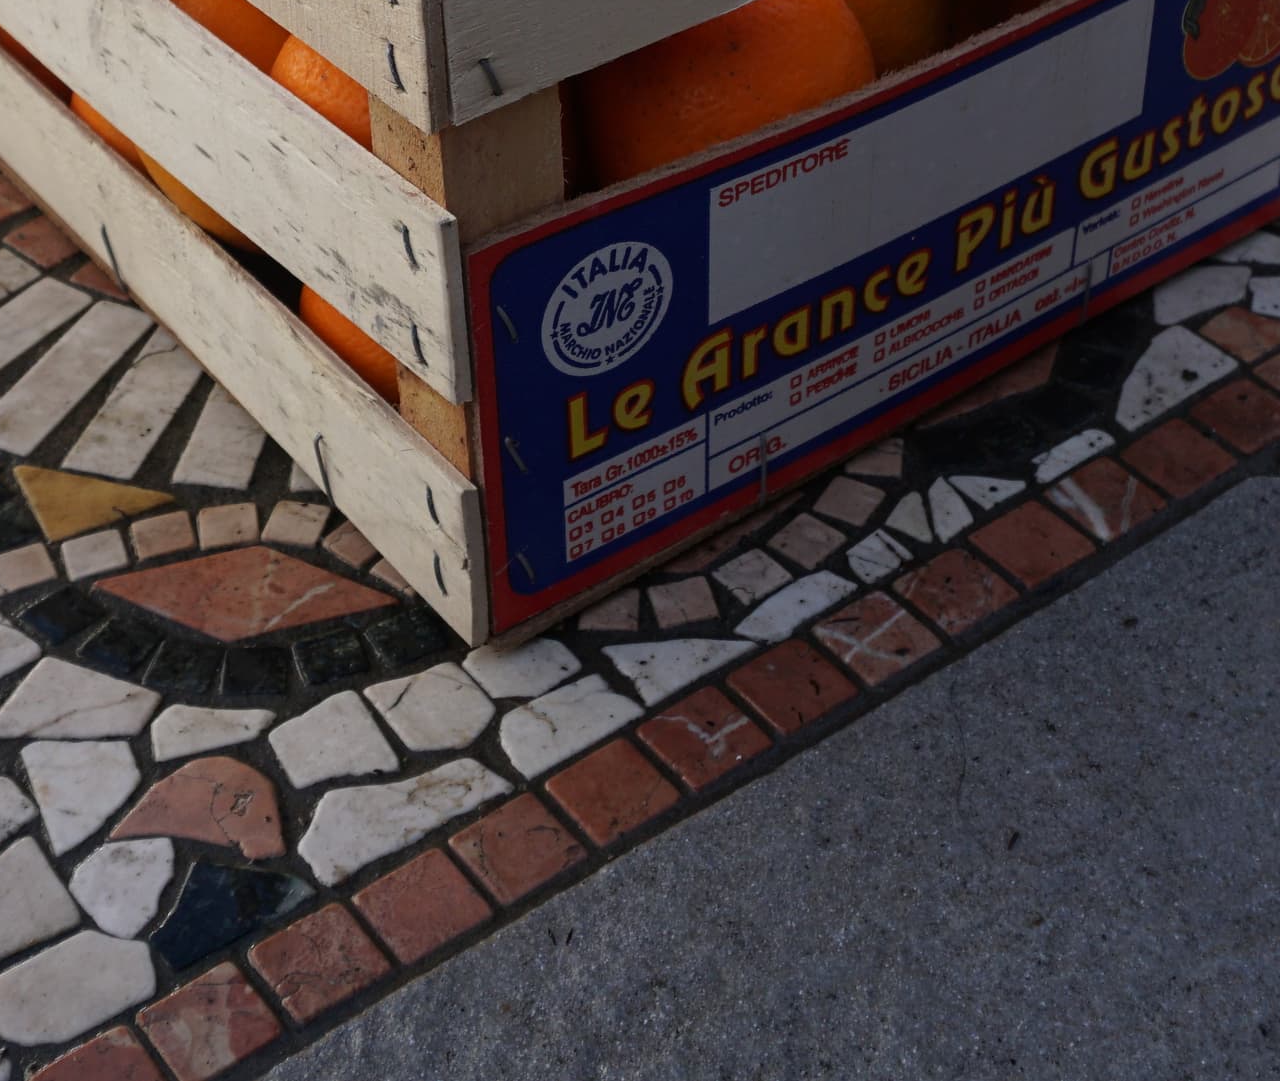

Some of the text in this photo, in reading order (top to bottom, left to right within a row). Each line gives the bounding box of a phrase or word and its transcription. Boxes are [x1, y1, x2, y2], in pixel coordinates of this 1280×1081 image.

[718, 138, 851, 207] SPEDITORE
[562, 246, 649, 300] ITALIA
[559, 285, 656, 360] MARCHIO NAZIONALE
[567, 378, 657, 462] Le
[680, 246, 933, 412] Arance
[954, 176, 1056, 274] Più
[888, 307, 965, 356] ALBICOCCHE
[889, 309, 932, 338] LIMONI
[807, 346, 860, 381] ARANCE
[714, 391, 773, 426] Prodotto:
[728, 436, 787, 474] ORG.
[888, 345, 953, 392] SICILIA
[968, 309, 1022, 349] ITALIA
[567, 483, 634, 524] CALIBRO:
[571, 475, 602, 498] Tara
